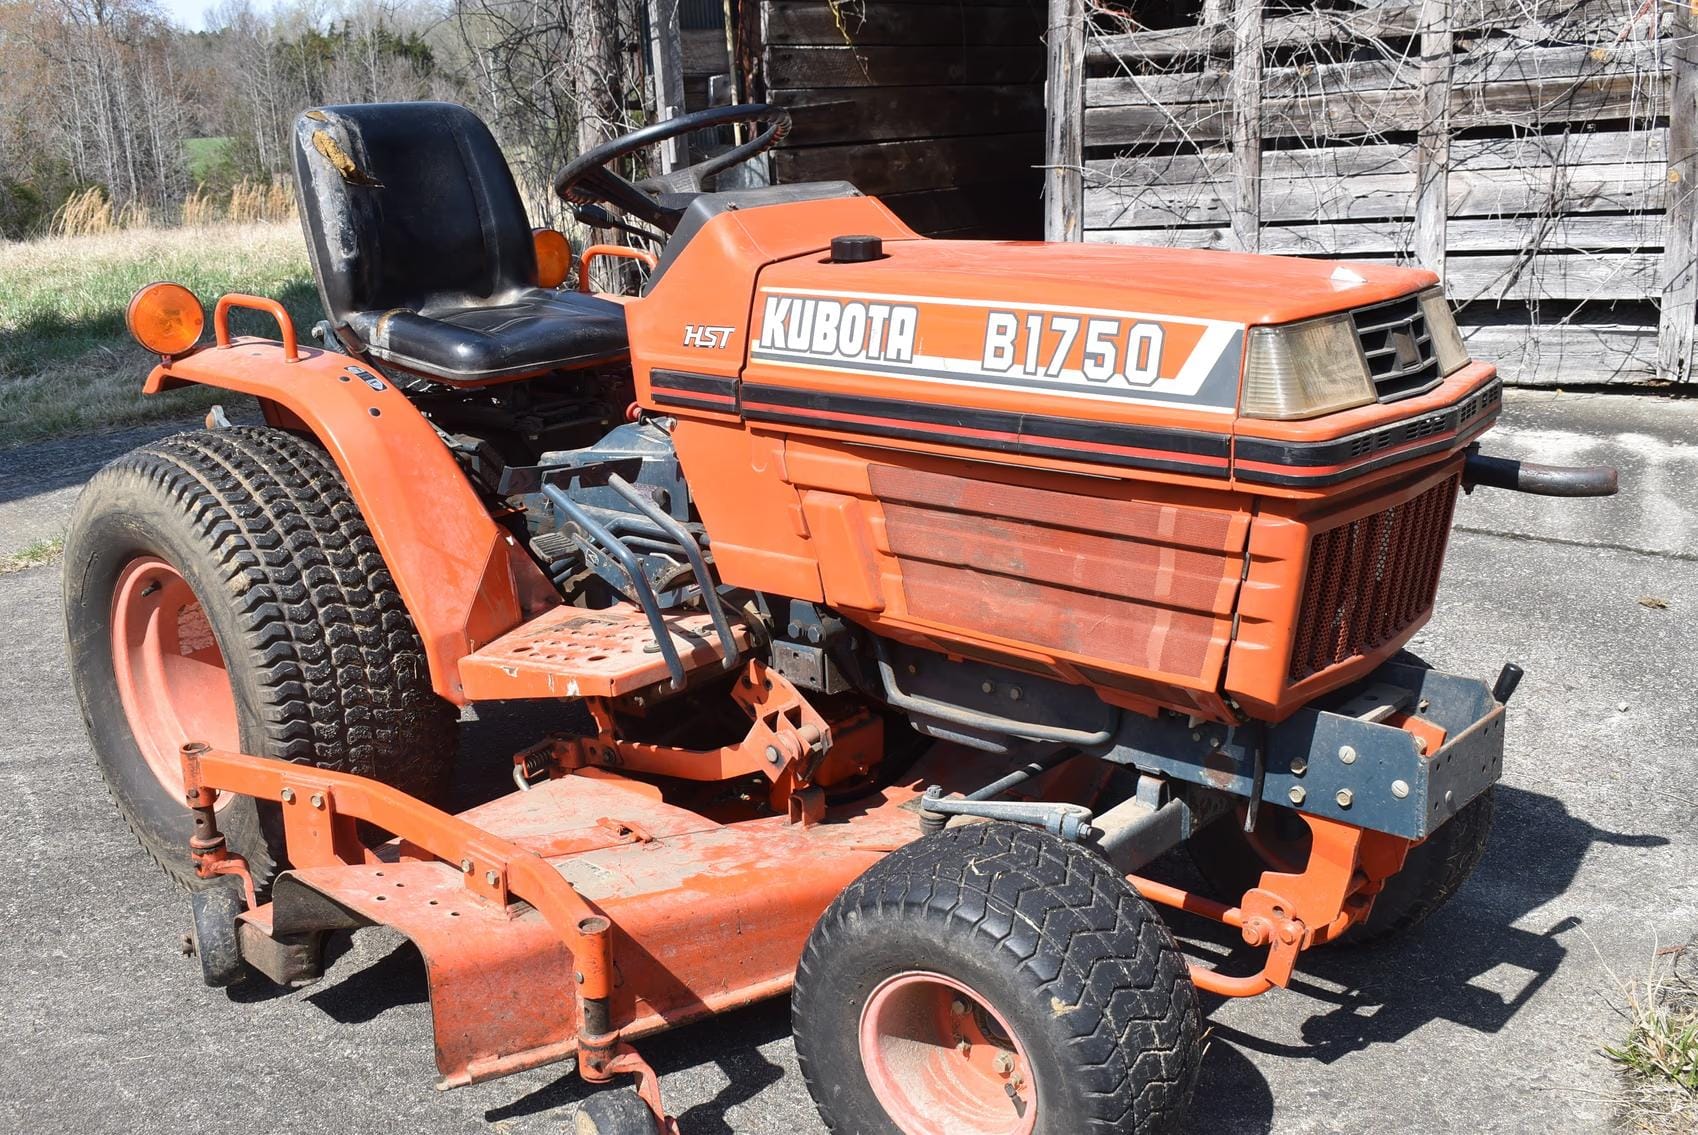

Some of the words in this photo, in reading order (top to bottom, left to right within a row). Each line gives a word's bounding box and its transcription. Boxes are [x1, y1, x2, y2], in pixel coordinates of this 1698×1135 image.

[683, 324, 736, 349] HST
[759, 295, 919, 364] KUBOTA
[981, 309, 1166, 387] B1750
